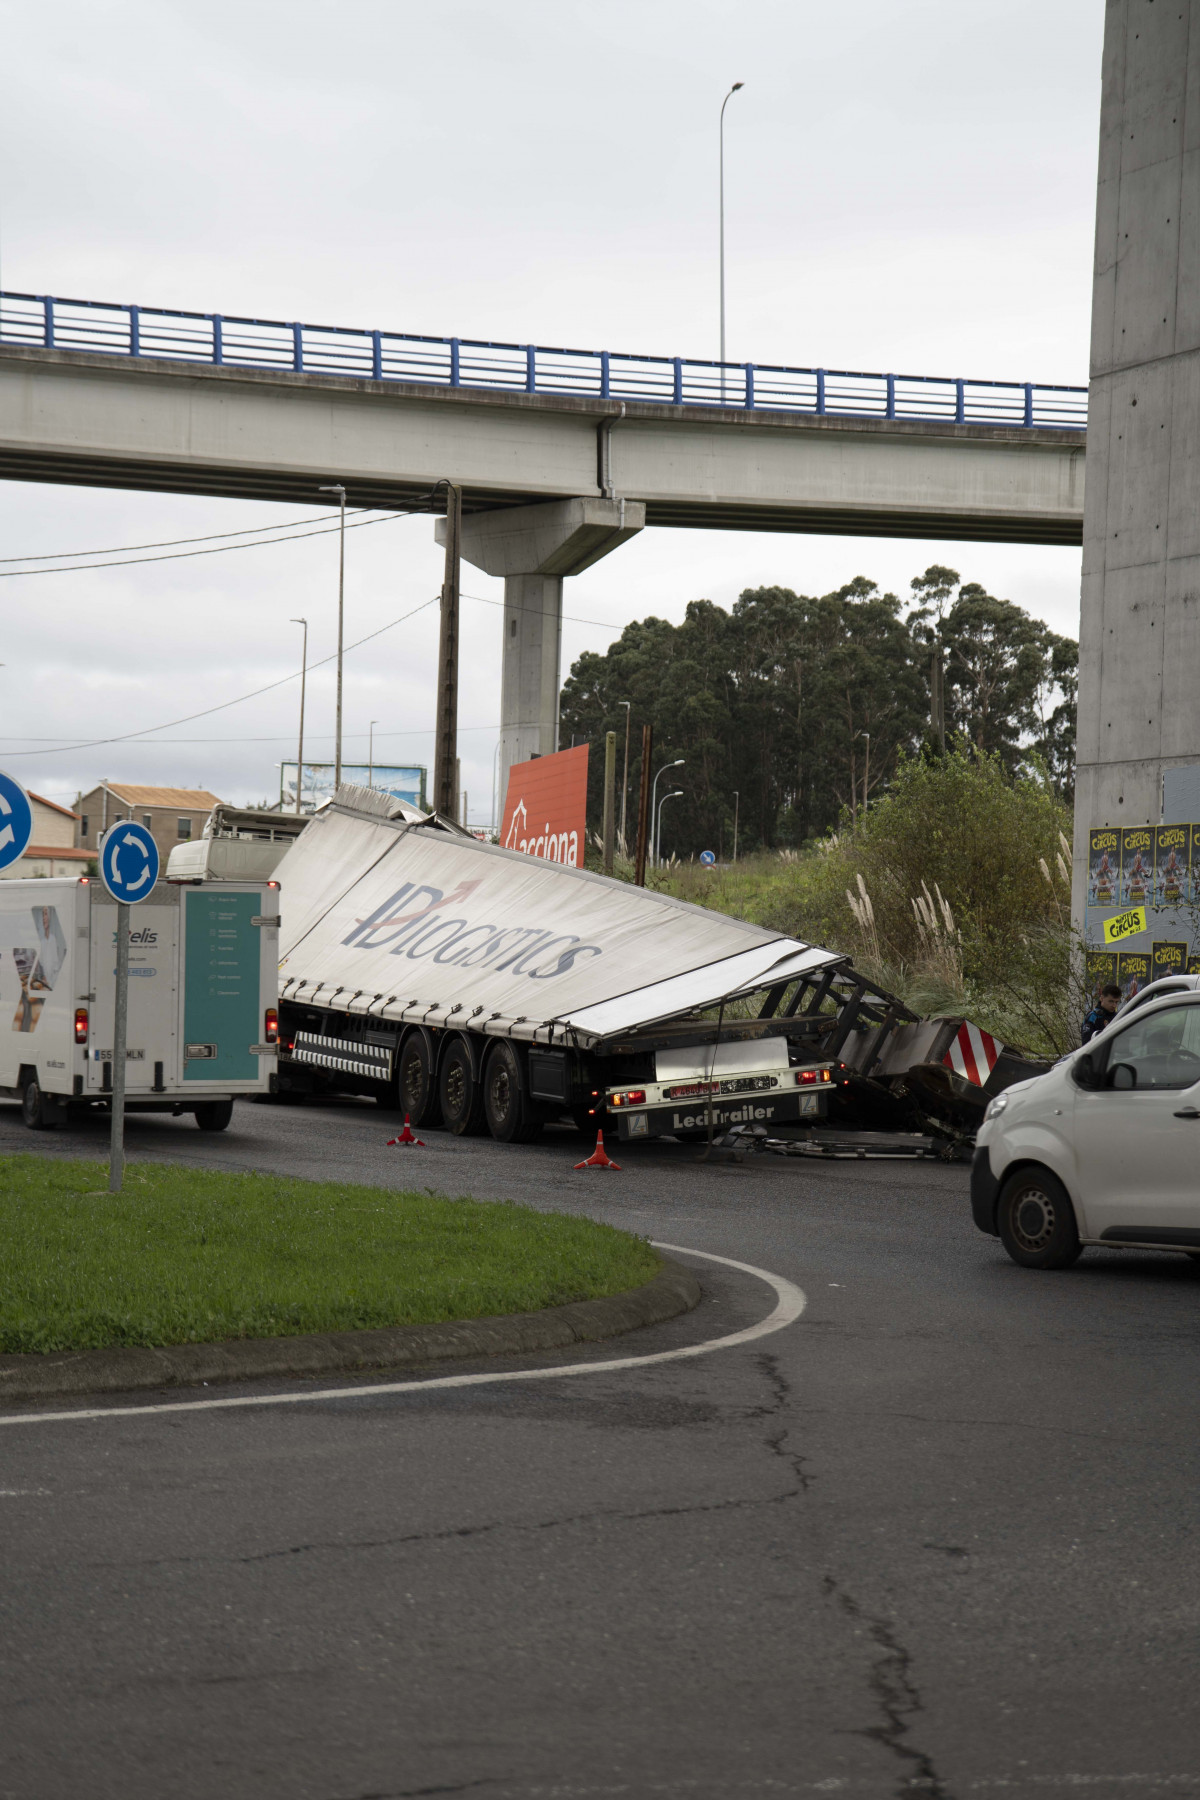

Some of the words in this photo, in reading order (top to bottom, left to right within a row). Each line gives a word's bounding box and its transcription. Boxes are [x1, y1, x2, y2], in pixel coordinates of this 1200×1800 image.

[520, 822, 578, 868] acciona
[130, 927, 158, 943] elis
[673, 1104, 775, 1129] LeciTrailer
